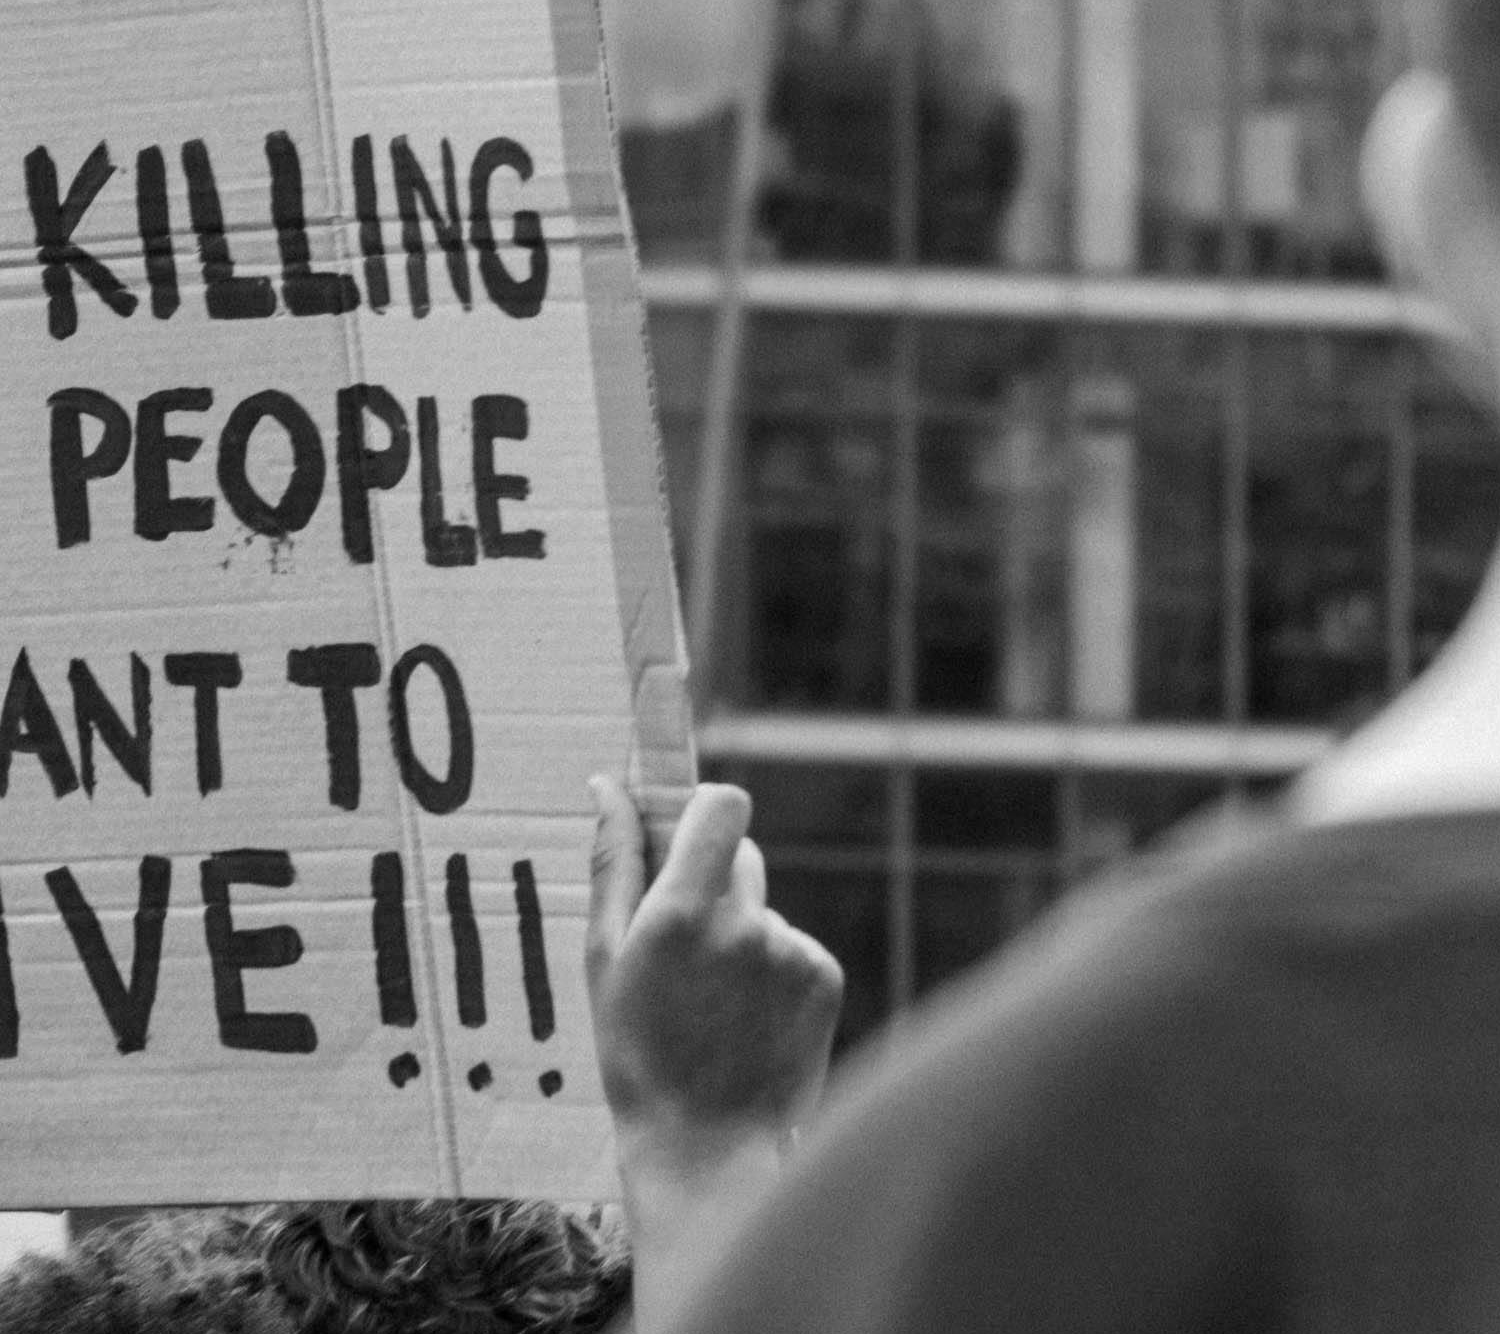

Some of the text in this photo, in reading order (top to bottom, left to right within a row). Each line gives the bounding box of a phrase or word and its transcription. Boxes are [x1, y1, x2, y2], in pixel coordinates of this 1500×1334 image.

[22, 129, 551, 342] KILLING
[46, 381, 547, 569] PEOPLE
[286, 641, 476, 816] TO
